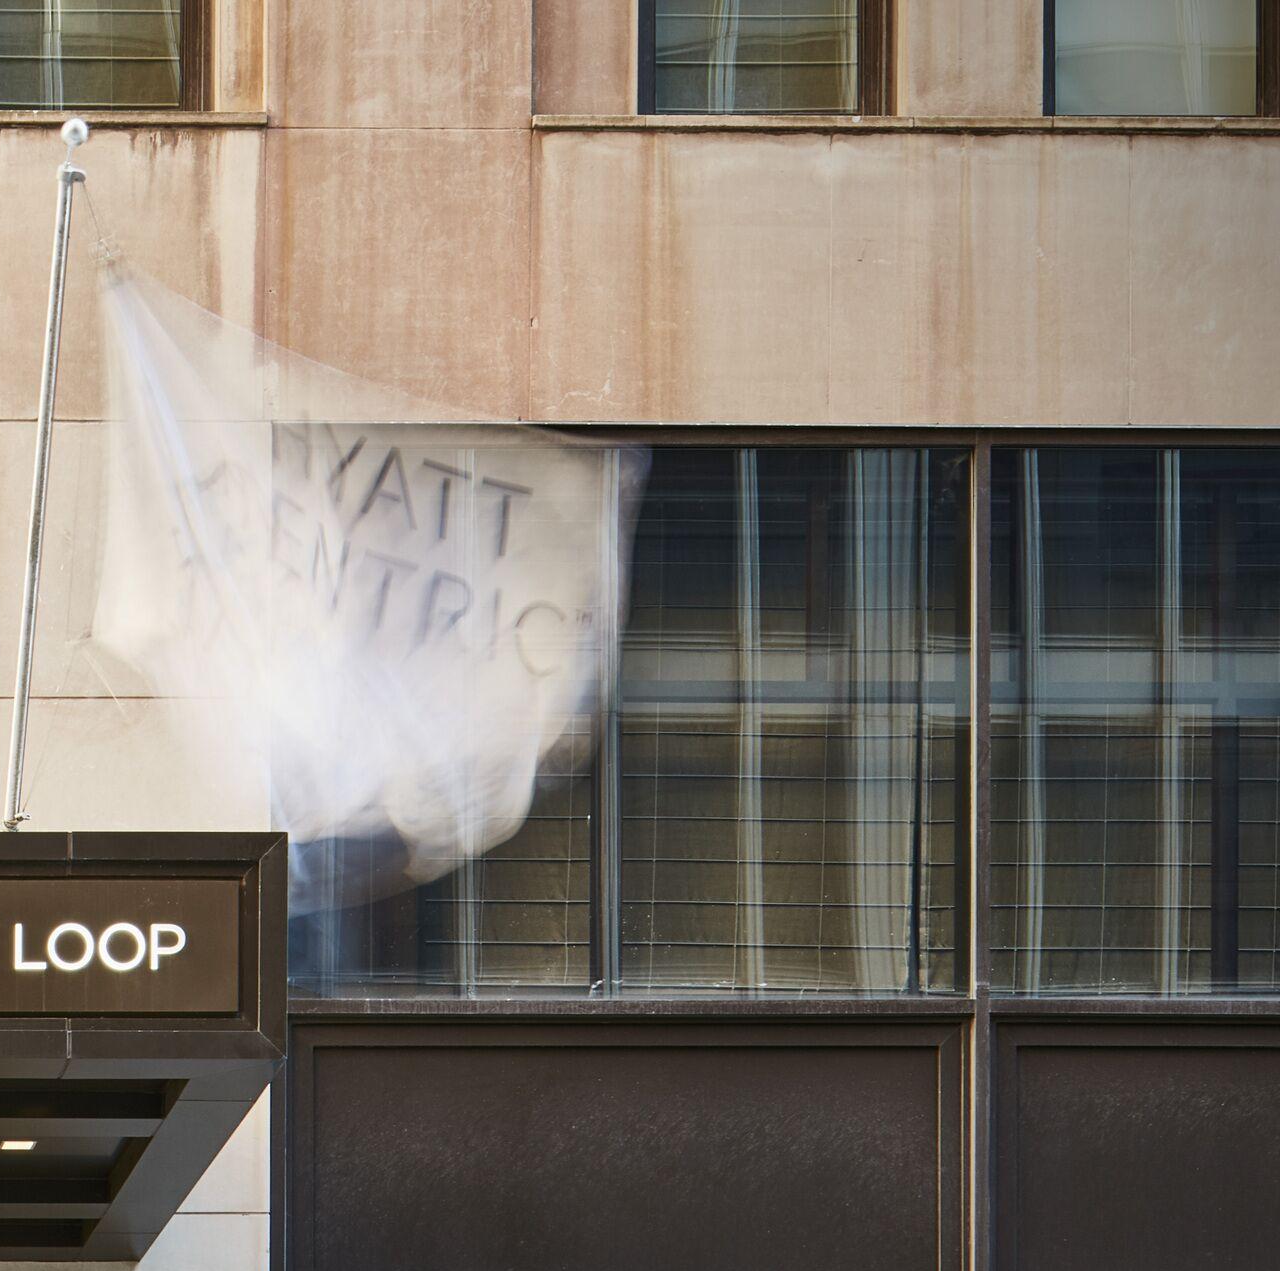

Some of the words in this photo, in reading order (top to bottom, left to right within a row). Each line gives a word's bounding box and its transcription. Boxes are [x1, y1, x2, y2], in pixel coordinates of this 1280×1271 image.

[271, 409, 533, 560] HYATT
[272, 489, 566, 677] ENTRIC
[14, 922, 187, 972] LOOP
